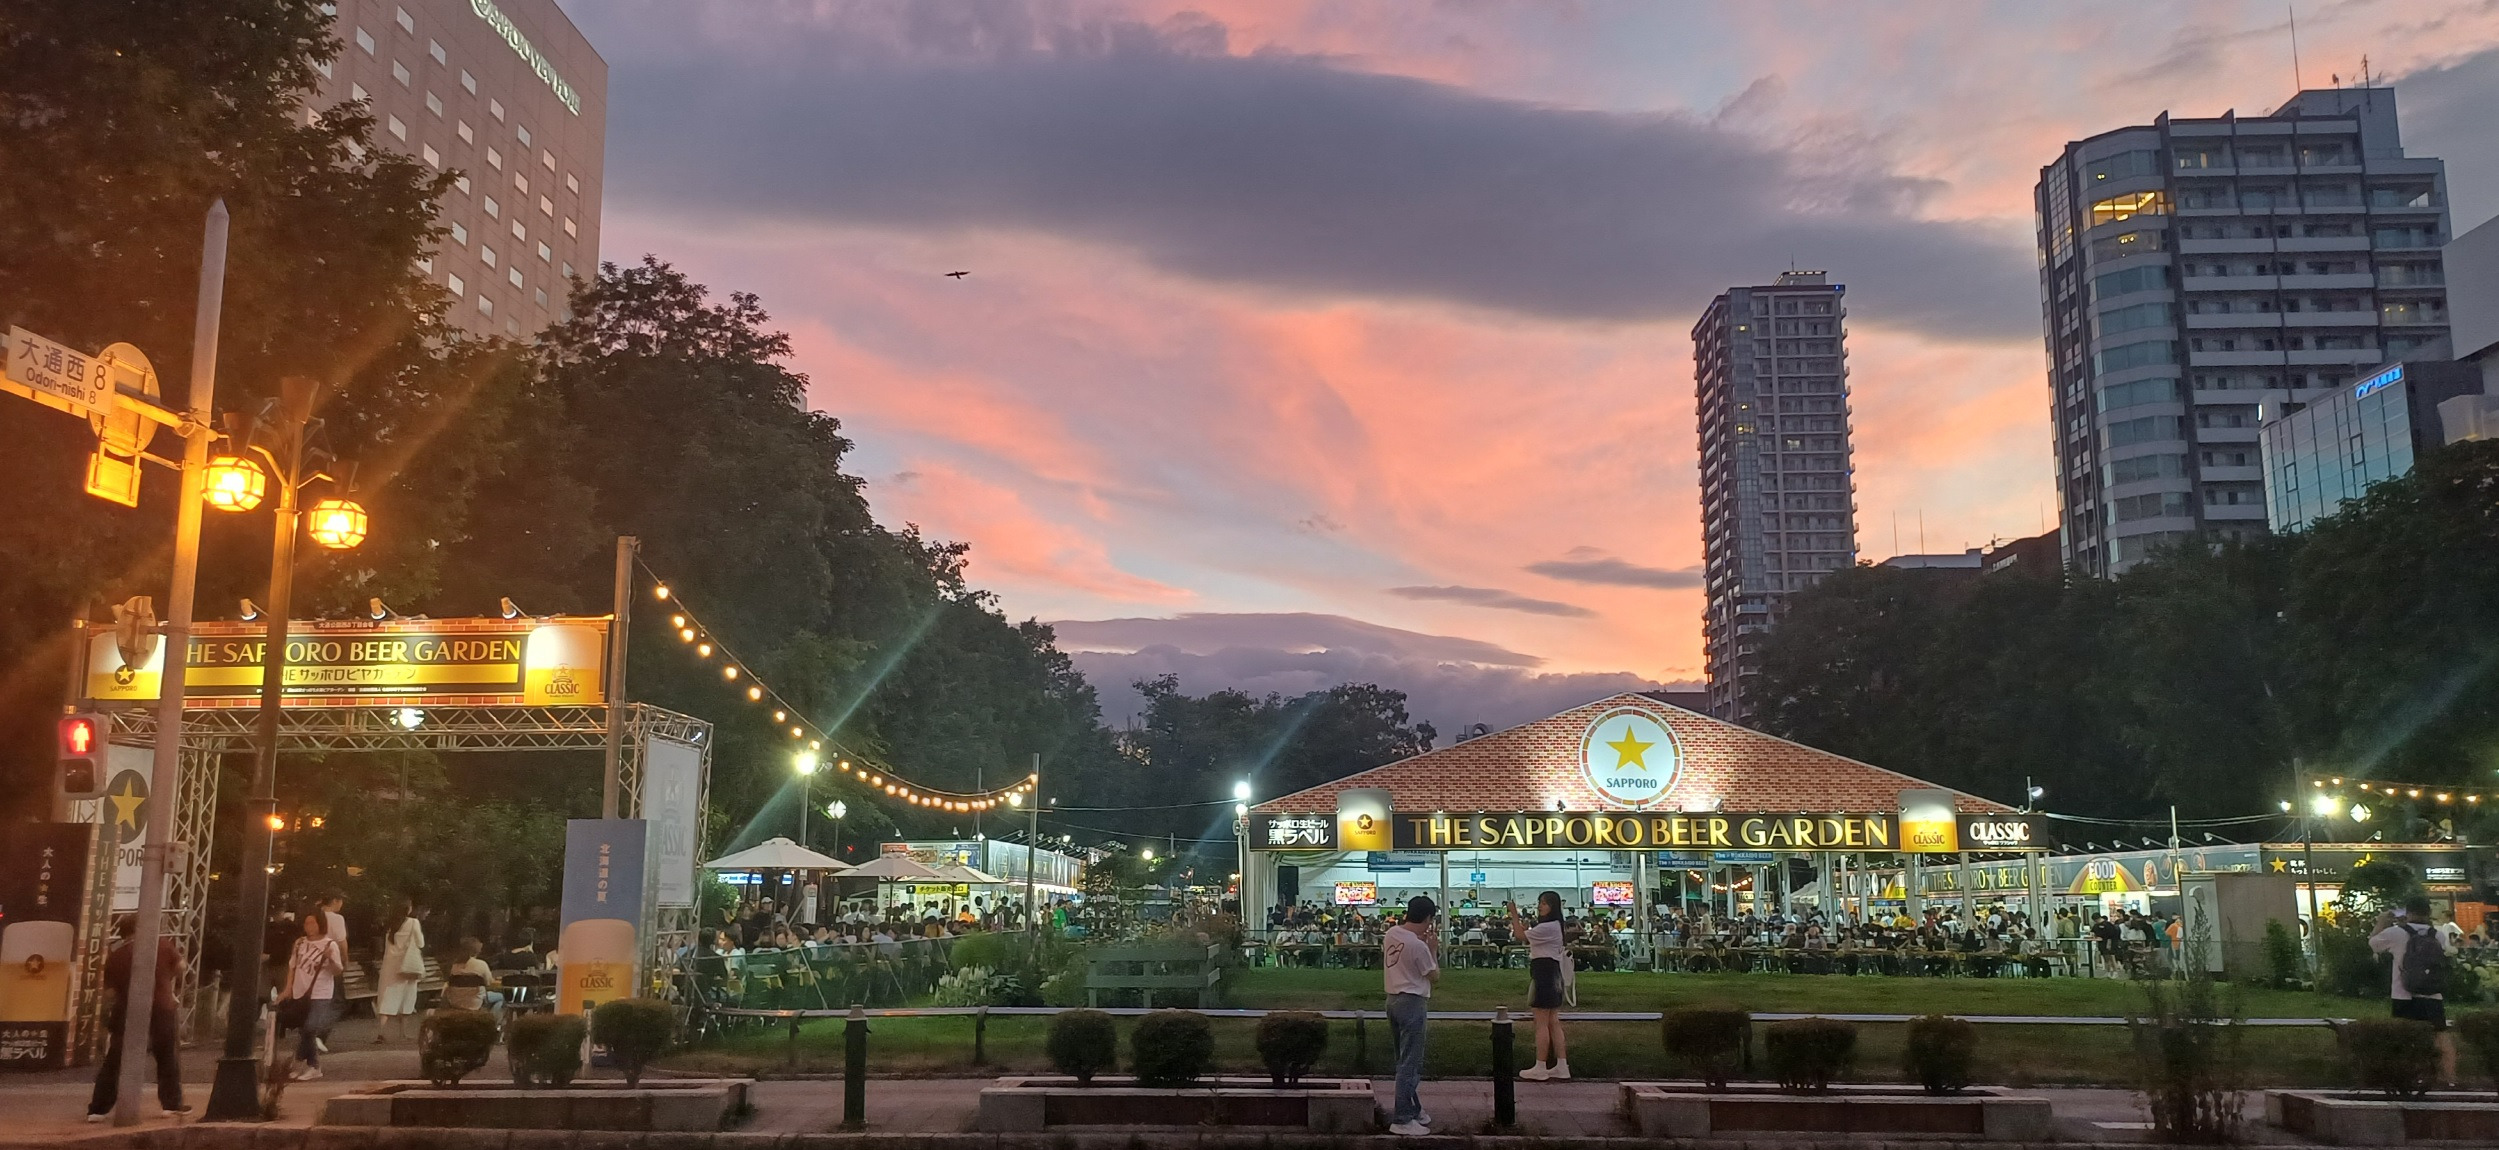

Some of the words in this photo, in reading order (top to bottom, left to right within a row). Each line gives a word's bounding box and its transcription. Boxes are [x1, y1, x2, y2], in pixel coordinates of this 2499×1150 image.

[19, 337, 86, 383] 大通西
[94, 365, 106, 391] 8
[26, 367, 85, 401] Odori-nishi
[88, 390, 97, 405] 8
[186, 643, 217, 664] HE
[222, 641, 341, 663] SAPORO
[350, 641, 409, 663] BEER
[414, 640, 521, 662] GARDEN
[544, 683, 580, 695] CLASSIC
[1606, 777, 1658, 789] SAPPORO
[1267, 819, 1330, 829] サッポロ生ビール
[1407, 817, 1473, 845] THE
[1479, 817, 1644, 846] SAPPORO
[1651, 817, 1733, 846] BEER
[1740, 818, 1889, 847] GARDEN
[1969, 822, 2030, 841] CLASSIC
[1267, 828, 1330, 846] 黒ラベル
[1912, 834, 1946, 846] CLASSIC
[1998, 867, 2020, 889] BEER
[2087, 861, 2117, 881] FOOD
[2089, 880, 2118, 891] COUNTER
[579, 977, 615, 989] CLASSIC
